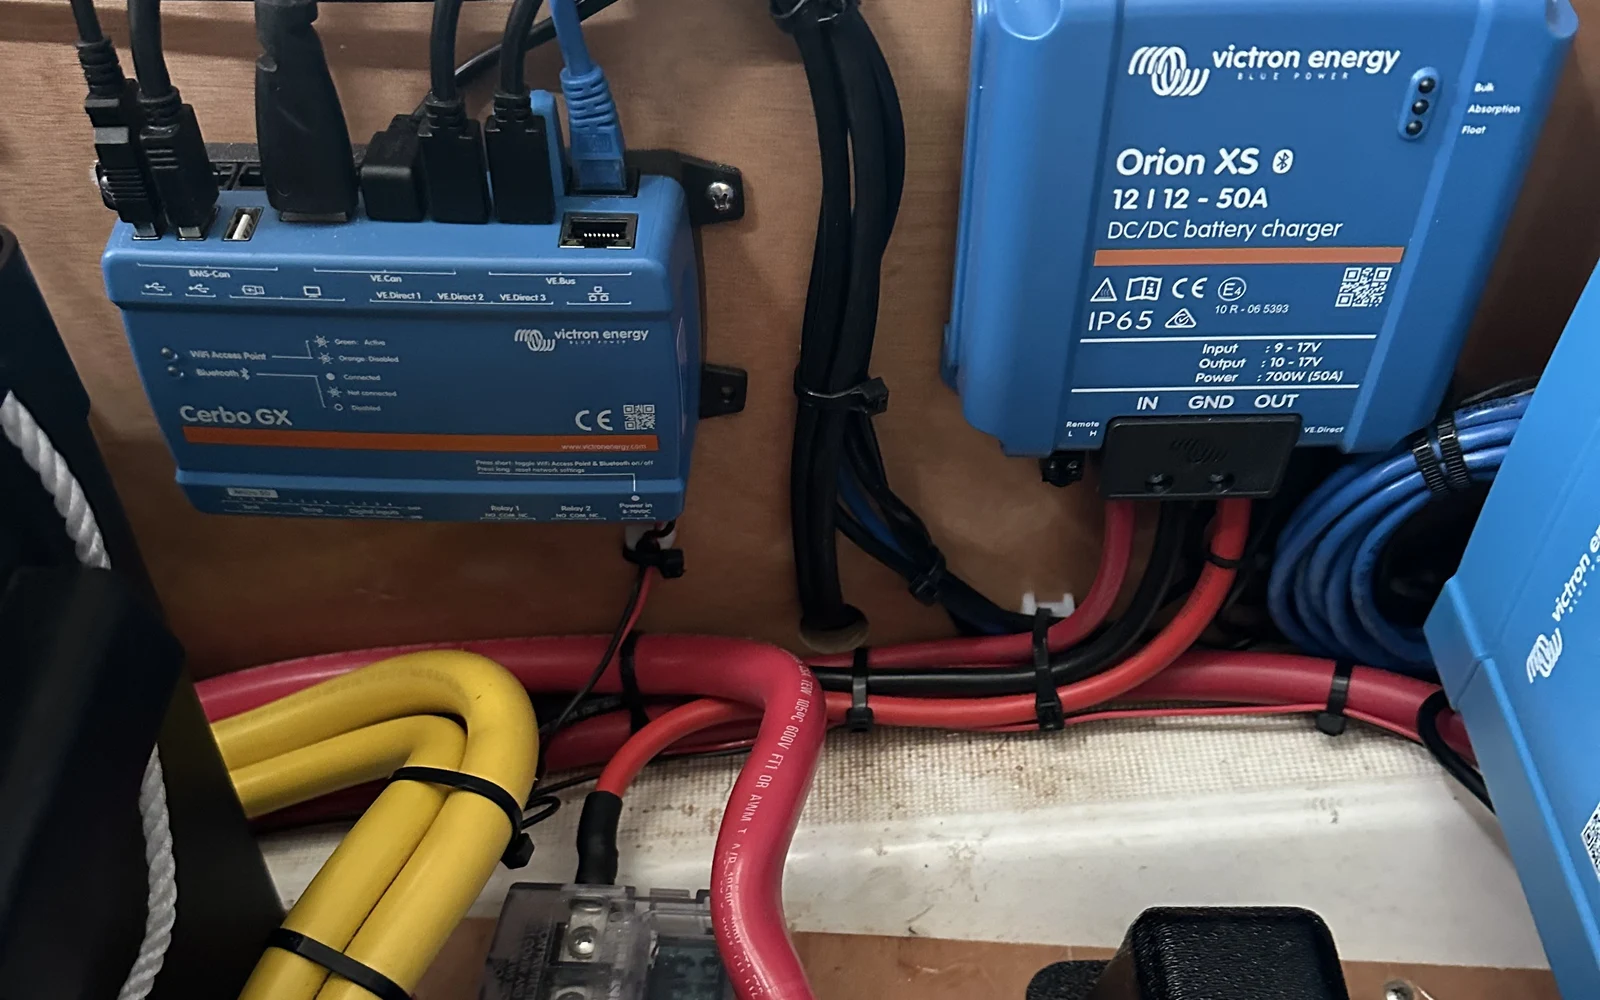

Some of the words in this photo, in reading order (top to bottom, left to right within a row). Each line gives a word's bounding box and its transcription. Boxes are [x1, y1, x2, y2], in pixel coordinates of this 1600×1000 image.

[1212, 44, 1301, 69] victron
[1307, 49, 1400, 75] energy
[1237, 71, 1280, 80] BLUE
[1294, 71, 1349, 80] POWER
[1474, 82, 1495, 92] Bulk
[1467, 103, 1521, 116] Absorption
[1461, 125, 1487, 135] Float
[1116, 146, 1206, 176] Orion
[1213, 147, 1260, 175] XS
[1112, 188, 1139, 210] 12
[1163, 188, 1190, 209] 12
[1215, 187, 1268, 209] 50A
[1107, 220, 1179, 240] DC/DC
[1184, 219, 1257, 242] battery
[1261, 219, 1344, 242] charger
[188, 269, 231, 279] BMS-Can
[369, 274, 403, 283] VE.Can
[545, 277, 576, 285] VE.Bus
[375, 291, 415, 300] VE.Direct
[416, 291, 422, 300] 1
[437, 292, 476, 301] VE.Direct
[477, 292, 485, 301] 2
[500, 293, 539, 301] VE.Direct
[540, 293, 547, 302] 3
[1215, 304, 1227, 314] 10
[1229, 304, 1239, 314] R
[1247, 303, 1261, 314] 06
[1263, 303, 1290, 314] 5393
[1088, 310, 1154, 331] IP65
[554, 328, 600, 340] victron
[602, 329, 649, 341] energy
[211, 350, 242, 359] Access
[243, 351, 267, 360] Point
[1201, 343, 1240, 357] Input
[1297, 341, 1323, 353] 17V
[368, 355, 399, 363] Disabled
[1198, 358, 1247, 371] Output
[1269, 357, 1285, 368] 10
[1298, 356, 1324, 367] 17V
[195, 368, 240, 377] Bluetooth
[1194, 372, 1239, 383] Power
[1265, 371, 1308, 382] 700W
[1307, 370, 1344, 383] (50A)
[1136, 396, 1159, 410] IN
[1188, 395, 1235, 410] GND
[1254, 394, 1300, 409] OUT
[179, 405, 251, 424] Cerbo
[255, 408, 293, 426] GX
[1303, 425, 1345, 434] VE.Direct
[561, 443, 647, 451] www.victronenergy.com
[1552, 553, 1591, 622] victron
[777, 725, 799, 750] 600V
[755, 774, 773, 789] OR
[740, 794, 763, 822] AWM
